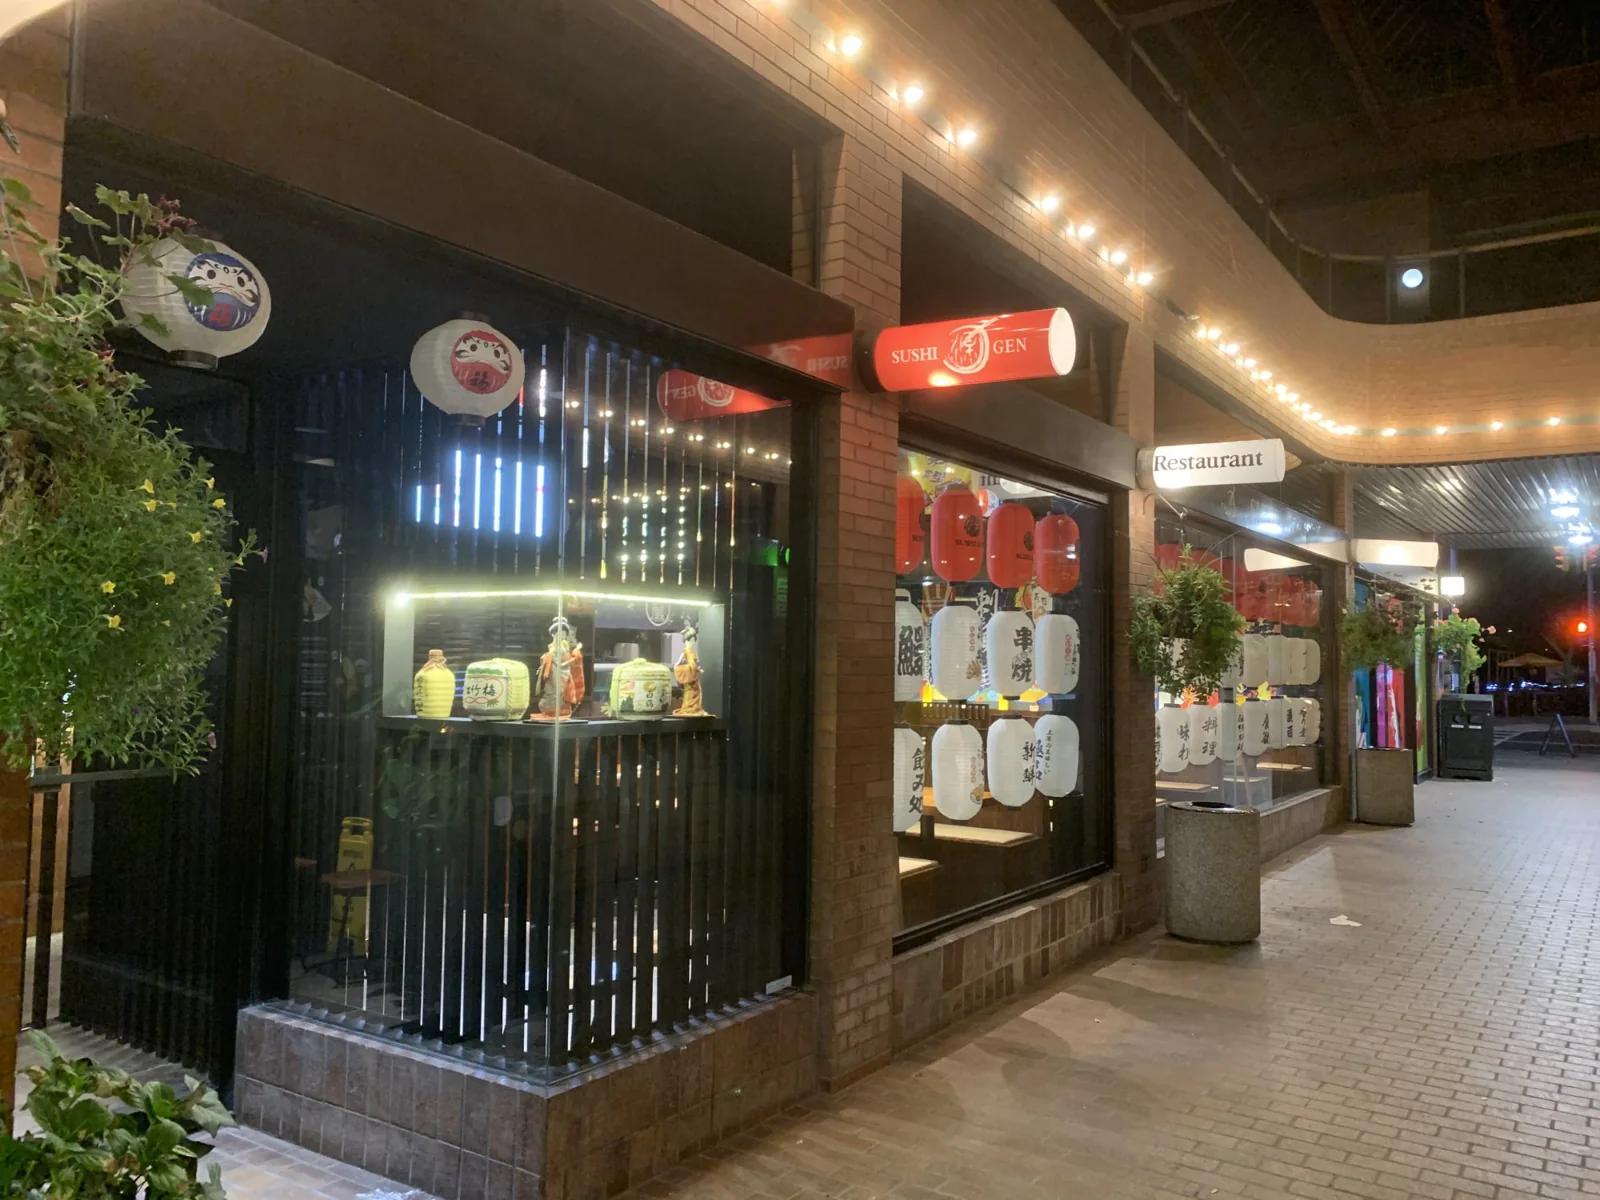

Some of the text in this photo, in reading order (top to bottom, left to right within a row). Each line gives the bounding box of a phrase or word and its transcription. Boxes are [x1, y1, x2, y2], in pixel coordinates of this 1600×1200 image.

[891, 337, 1028, 364] SUSHI GEN
[1153, 451, 1264, 472] Restaurant
